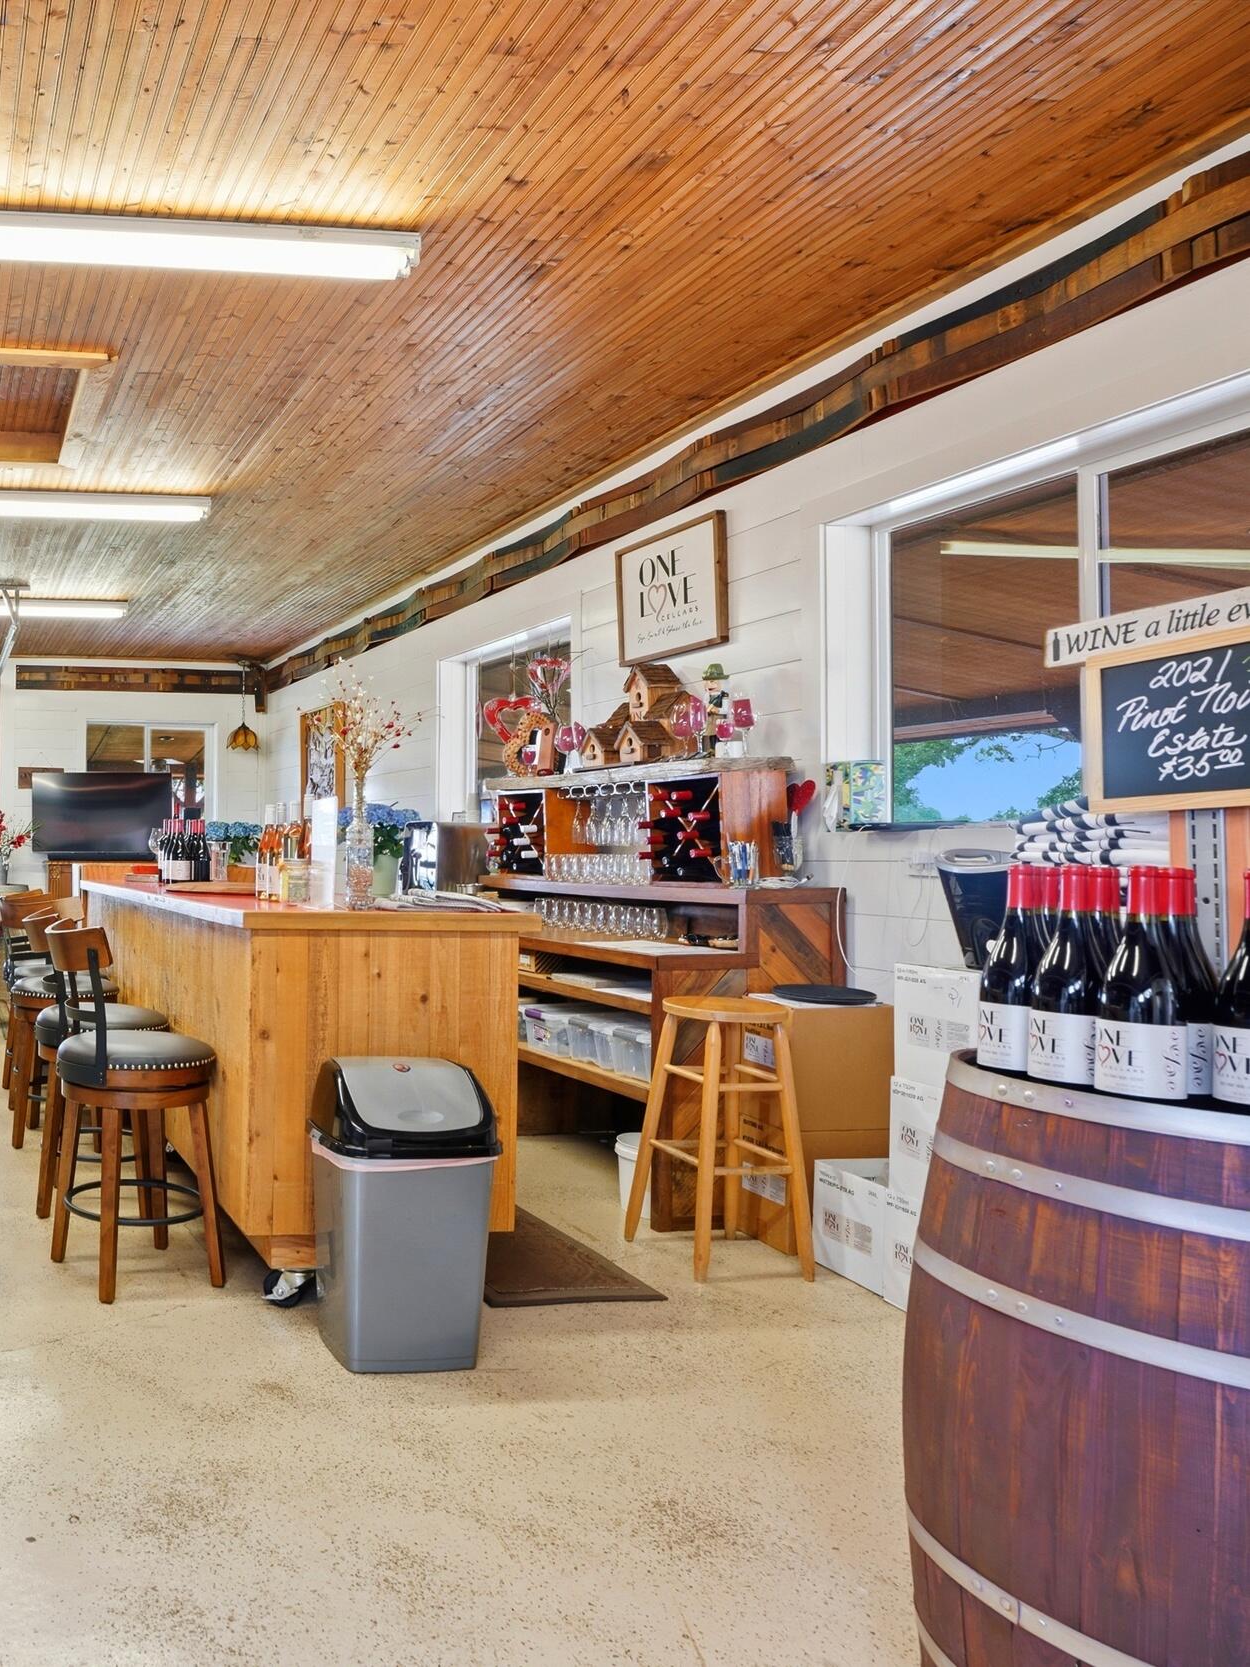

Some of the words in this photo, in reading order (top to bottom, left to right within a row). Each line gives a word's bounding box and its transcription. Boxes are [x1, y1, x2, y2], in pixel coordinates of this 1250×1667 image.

[639, 546, 685, 587] ONE
[661, 605, 699, 622] CELLARS
[1066, 620, 1139, 655] WINE
[1145, 619, 1160, 638] a
[1167, 602, 1220, 634] little
[1149, 649, 1232, 689] 2021
[1116, 696, 1189, 733] Pinot
[1190, 681, 1250, 713] Noi
[1148, 723, 1248, 758] Estate
